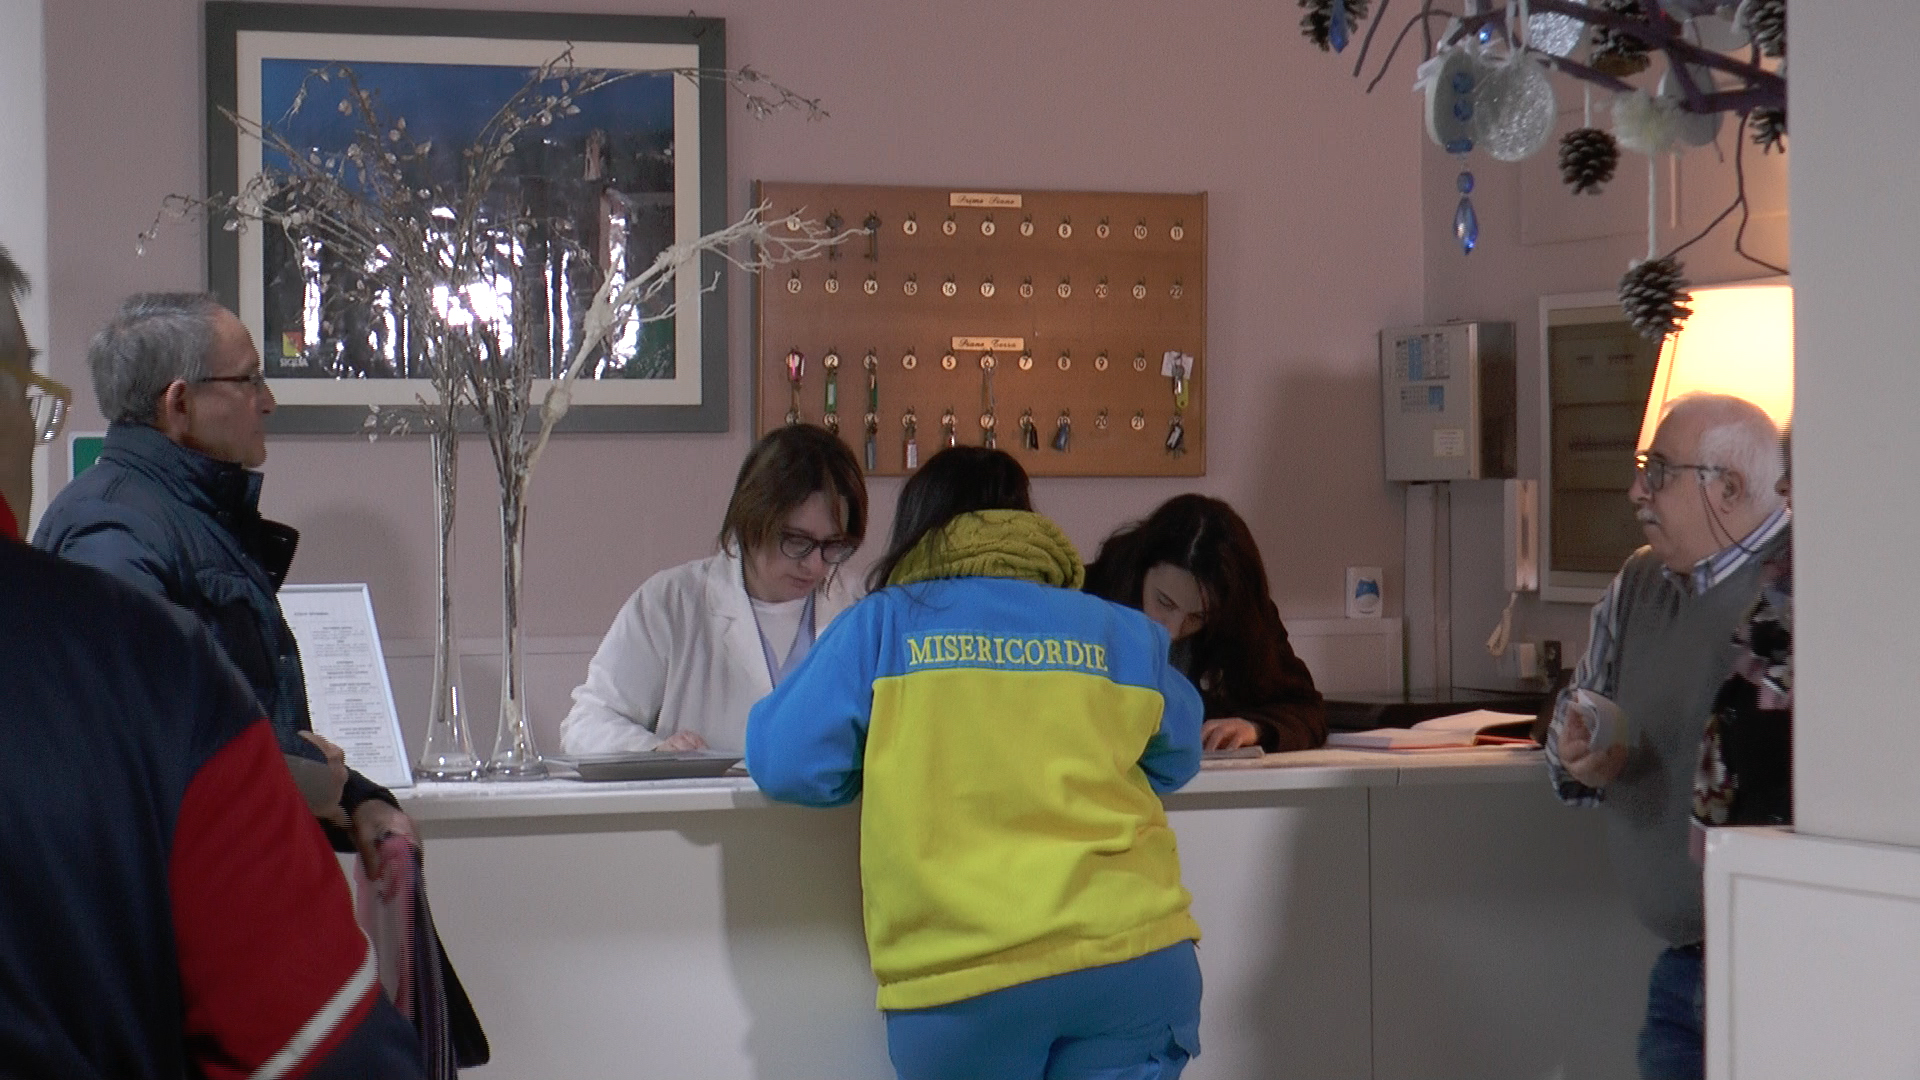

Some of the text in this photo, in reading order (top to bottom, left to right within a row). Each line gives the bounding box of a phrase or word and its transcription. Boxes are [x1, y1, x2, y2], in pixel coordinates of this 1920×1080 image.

[958, 338, 1016, 348] Piano Terra
[907, 634, 1109, 672] MISERICORDIE
